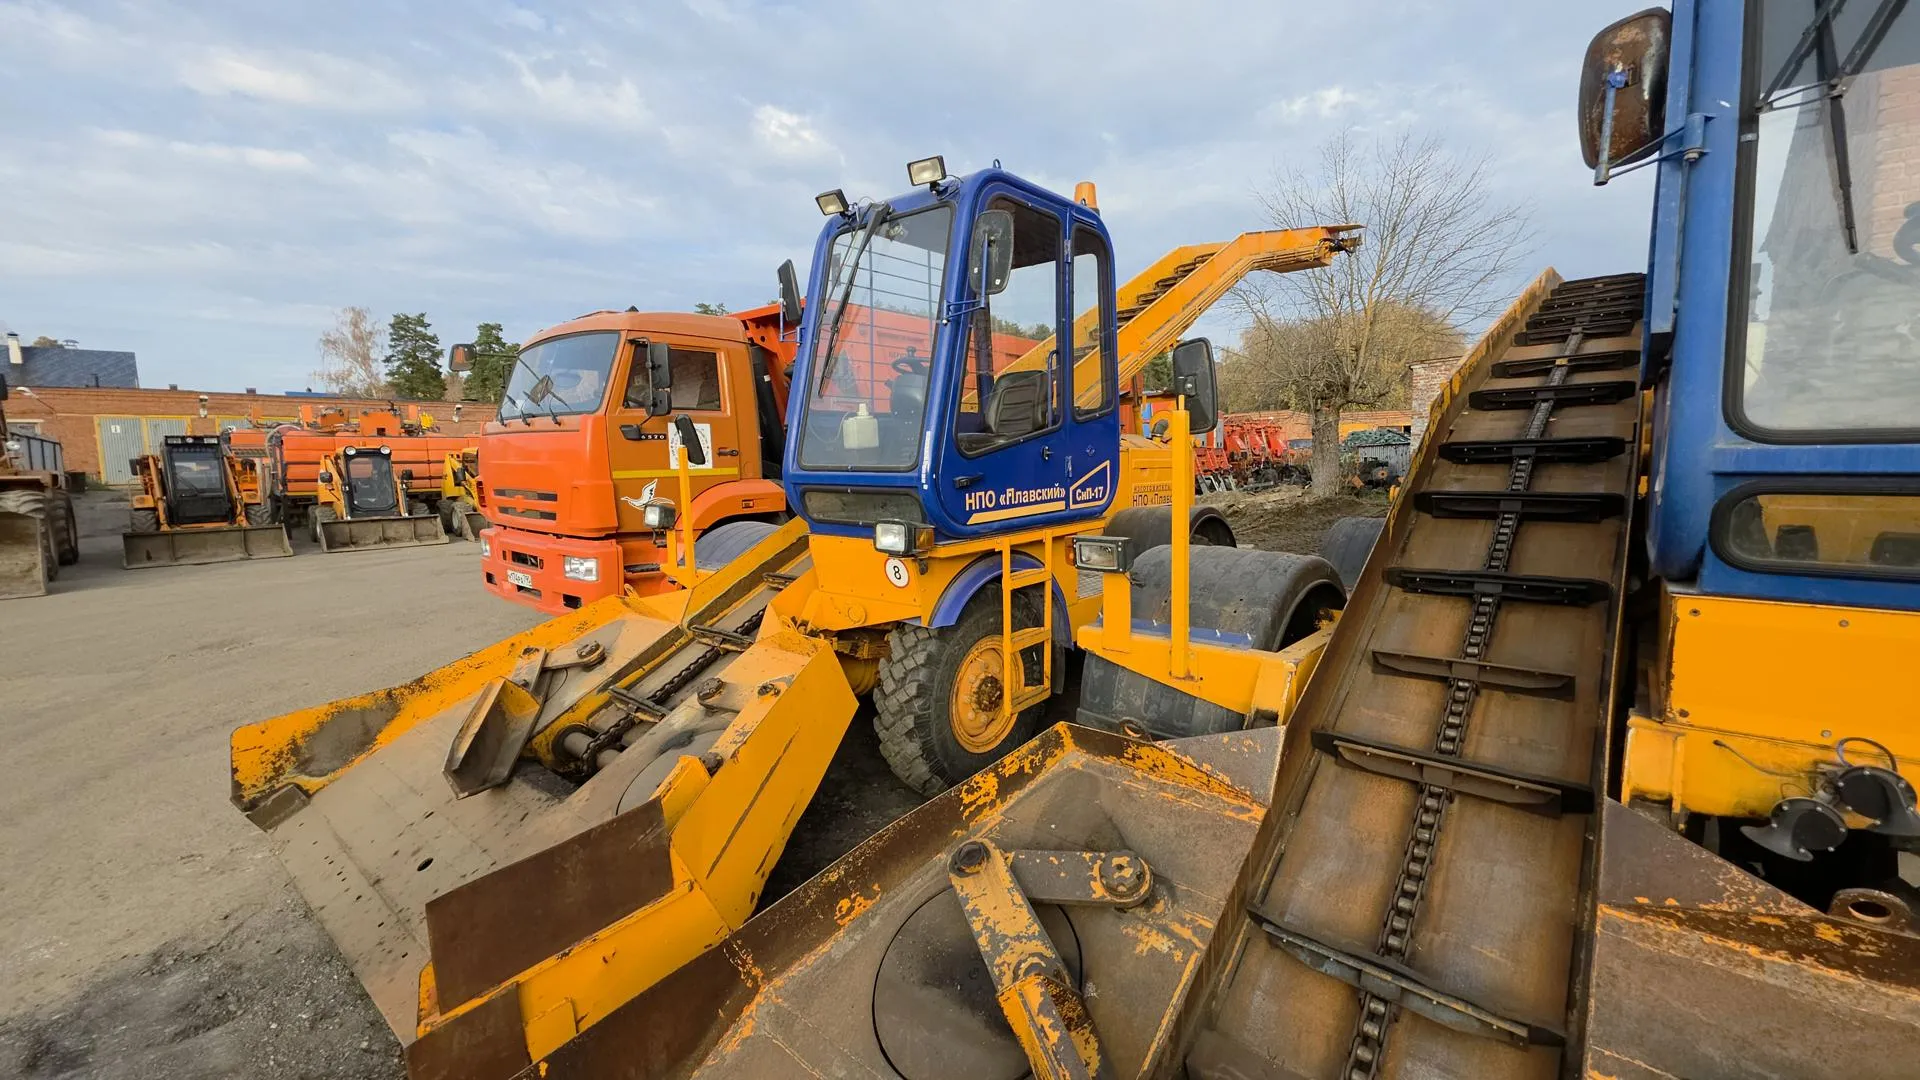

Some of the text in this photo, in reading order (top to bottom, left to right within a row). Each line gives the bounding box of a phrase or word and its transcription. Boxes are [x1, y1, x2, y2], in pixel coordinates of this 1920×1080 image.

[965, 482, 1066, 511] НПО «Плавский»
[1132, 494, 1148, 508] НПО
[893, 565, 902, 580] 8
